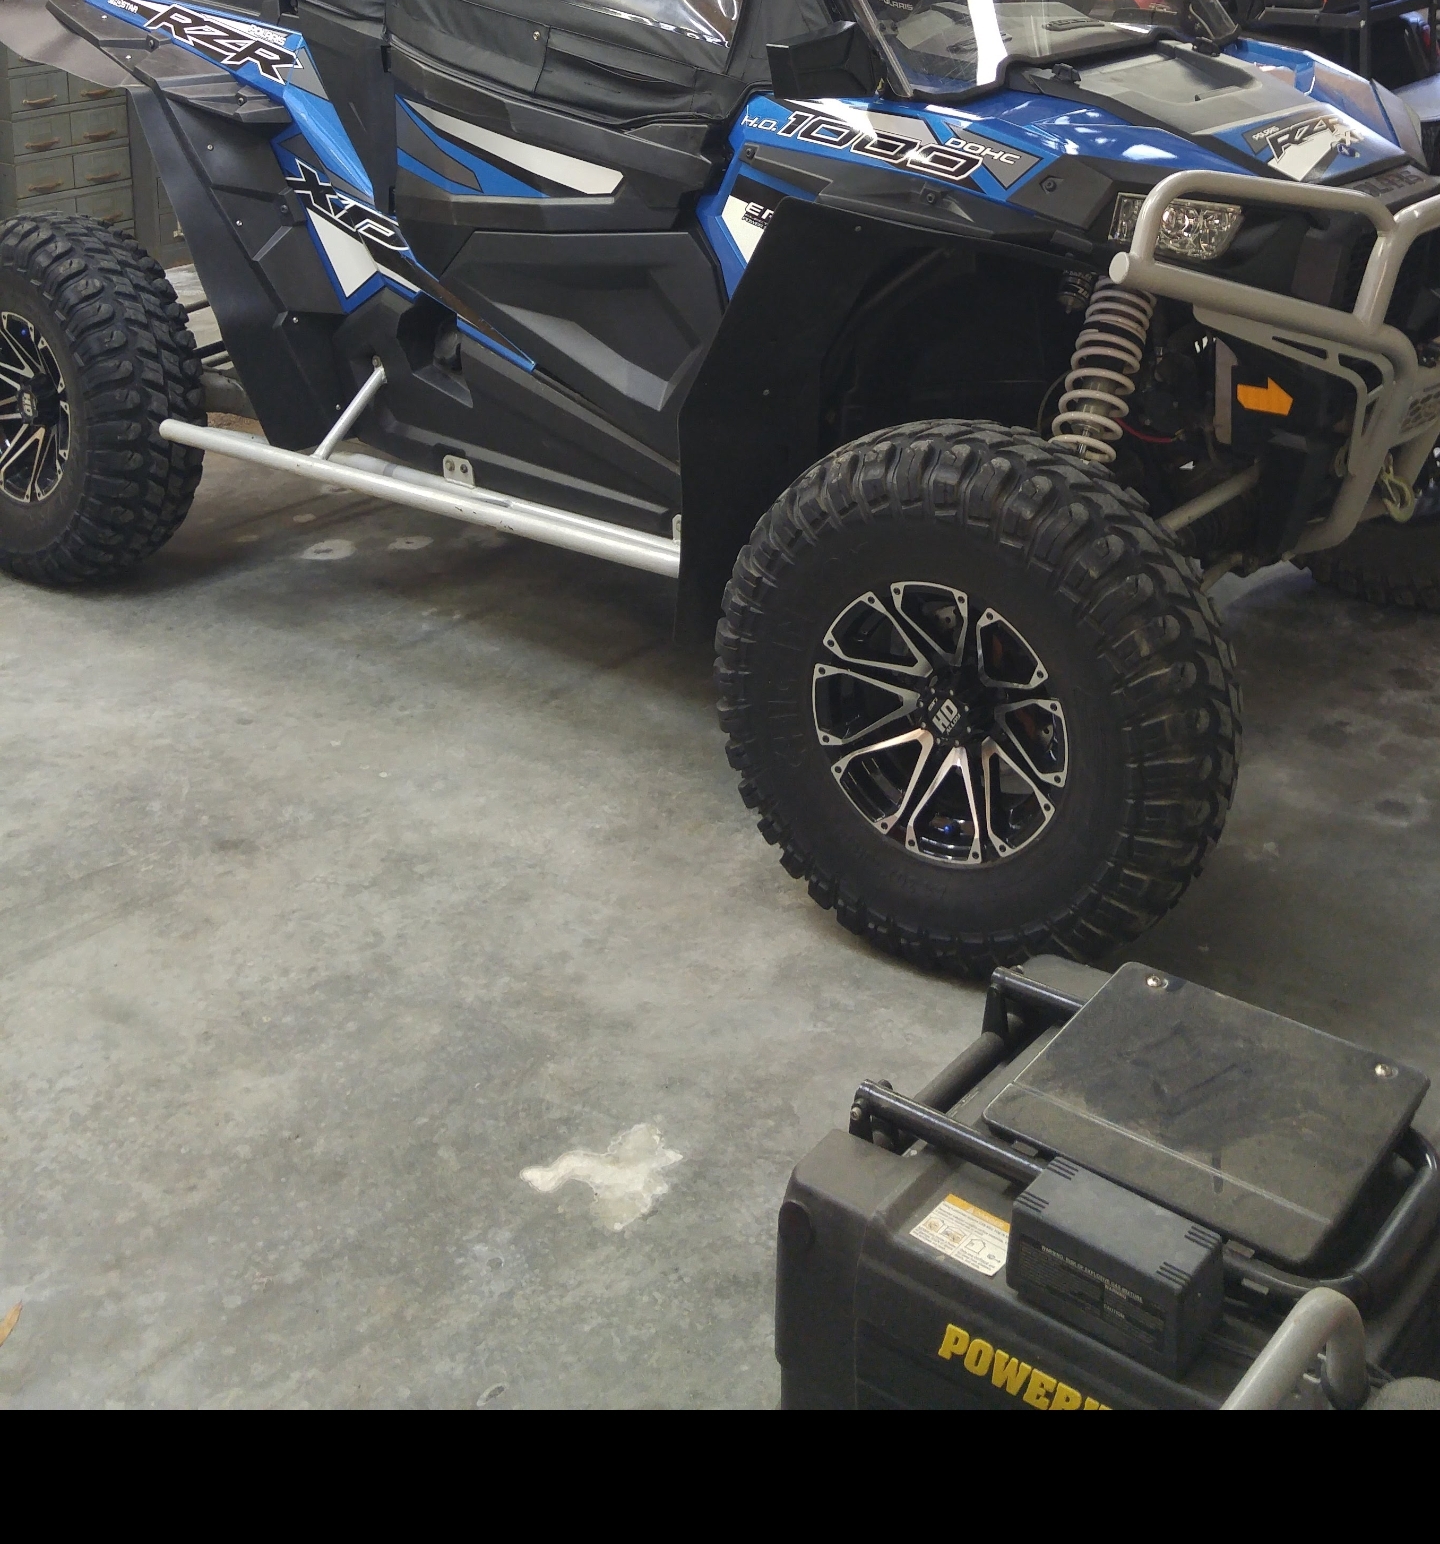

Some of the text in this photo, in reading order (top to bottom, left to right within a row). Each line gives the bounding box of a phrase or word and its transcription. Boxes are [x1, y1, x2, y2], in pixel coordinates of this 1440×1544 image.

[143, 2, 305, 86] RZR
[740, 110, 1022, 182] H.O. 1000 DOHC
[285, 157, 410, 251] XP
[931, 698, 958, 734] HD
[938, 1323, 1114, 1411] POWER
